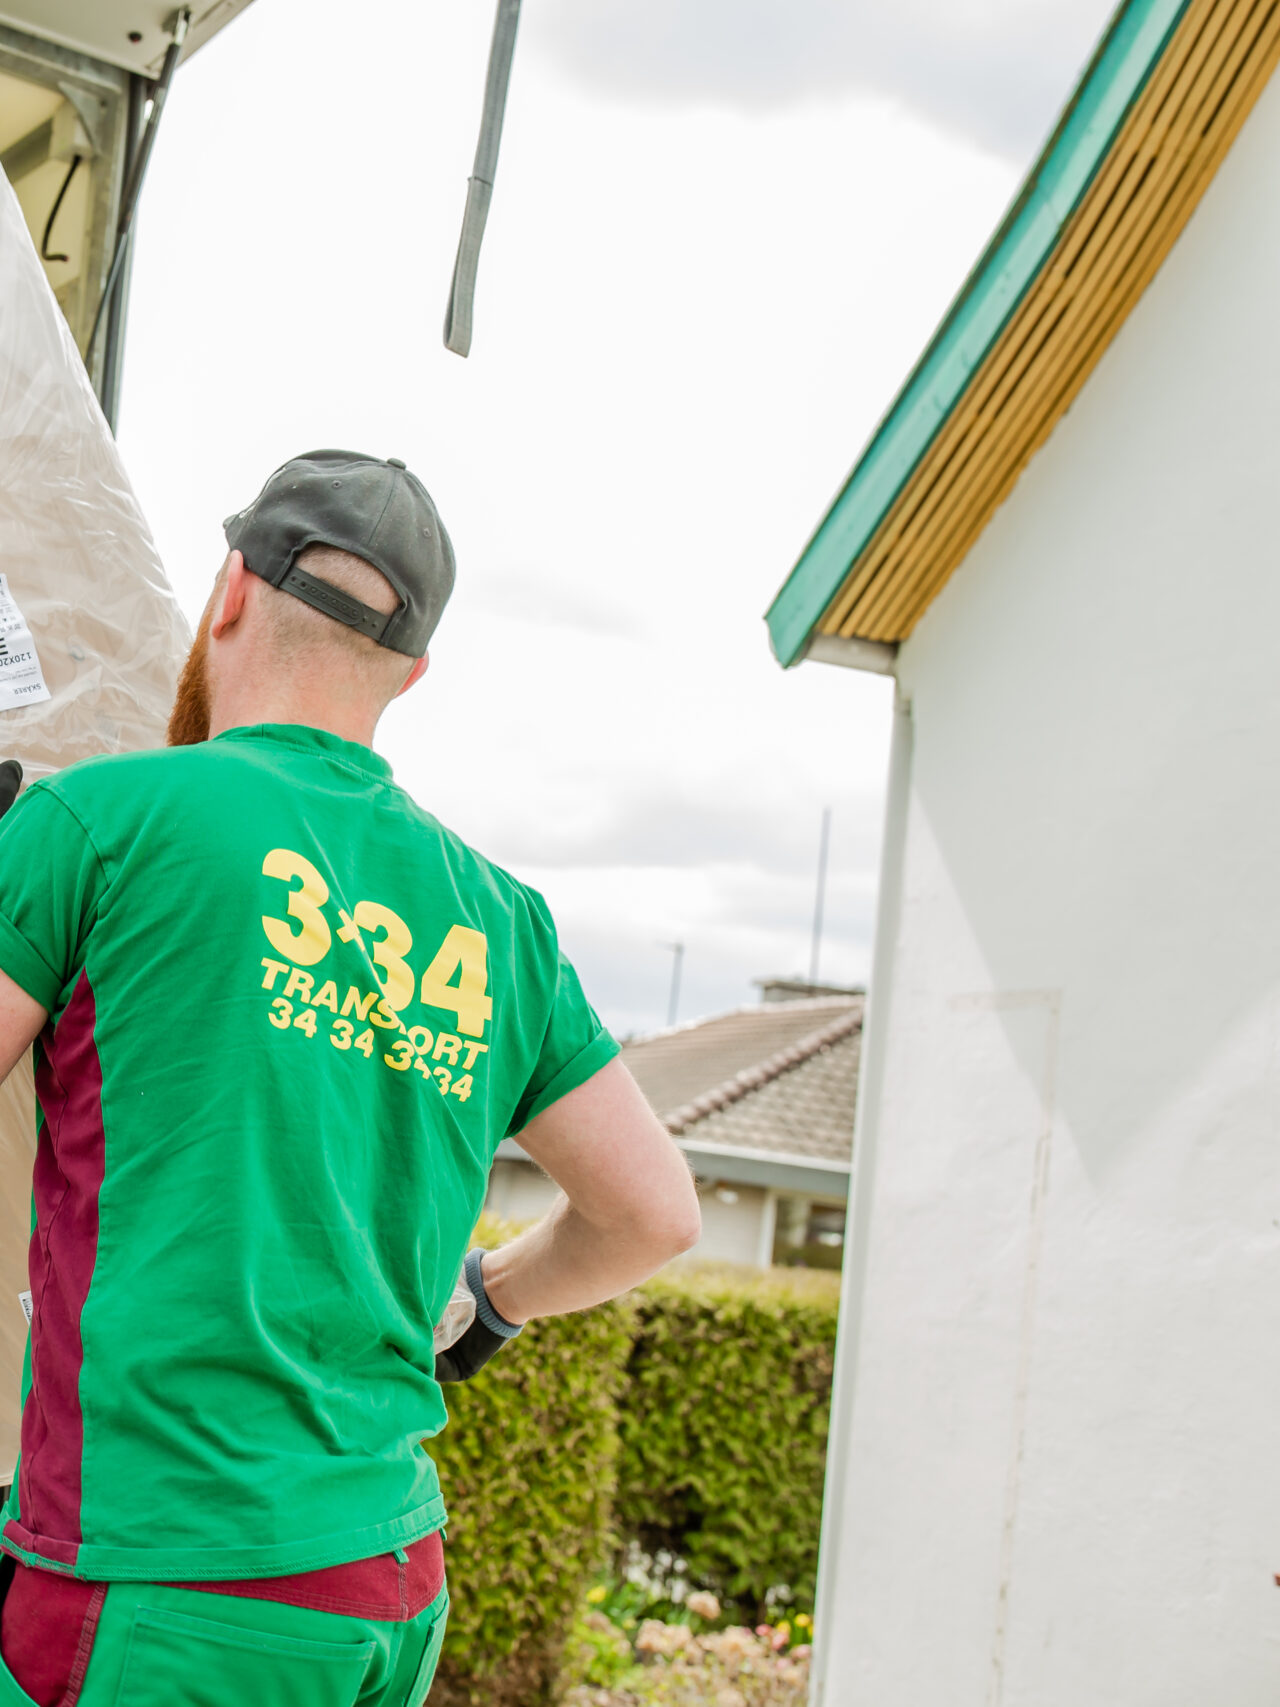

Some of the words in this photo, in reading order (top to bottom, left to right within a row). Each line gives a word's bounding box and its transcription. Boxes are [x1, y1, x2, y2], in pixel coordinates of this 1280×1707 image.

[261, 957, 489, 1071] TRANSORT
[268, 997, 318, 1038] 34
[329, 1018, 375, 1058] 34
[433, 1066, 474, 1103] 34
